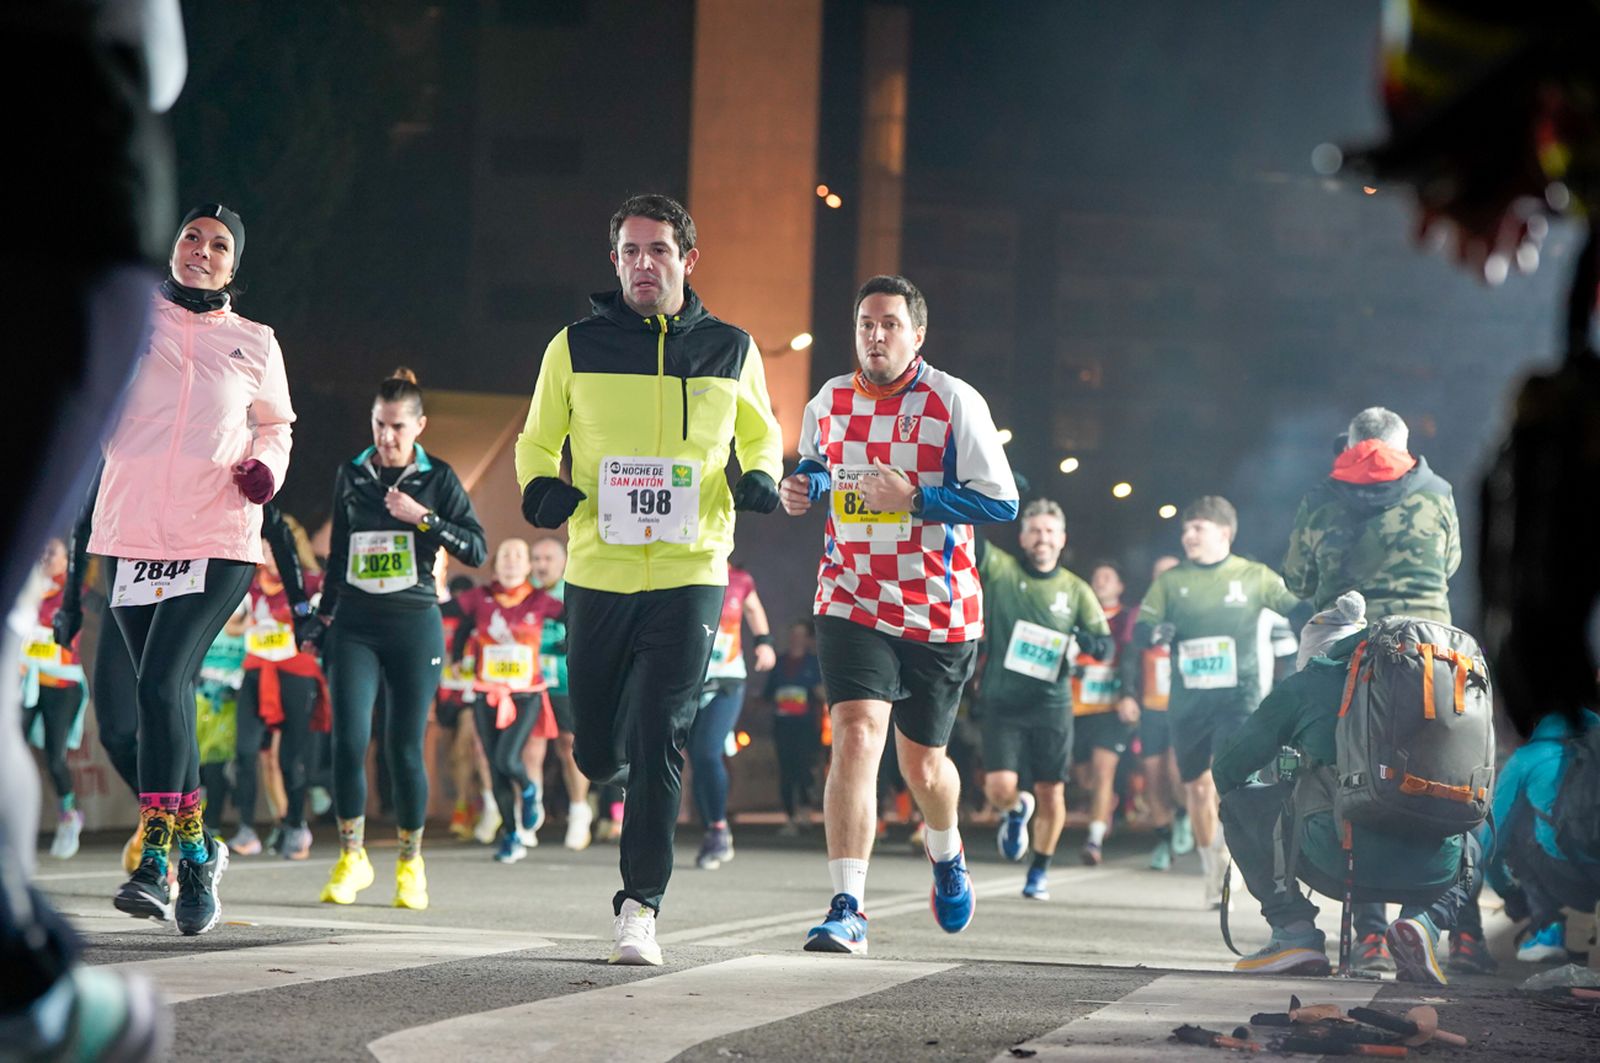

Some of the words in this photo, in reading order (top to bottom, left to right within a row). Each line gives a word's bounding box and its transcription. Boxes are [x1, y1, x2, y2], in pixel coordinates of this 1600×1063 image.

[622, 466, 651, 476] NOCHE
[652, 467, 664, 476] DE
[610, 476, 630, 487] SAN
[631, 475, 664, 488] ANTÓN
[838, 481, 853, 490] SAN
[627, 489, 671, 516] 198
[844, 492, 896, 515] 82
[133, 560, 191, 584] 2844
